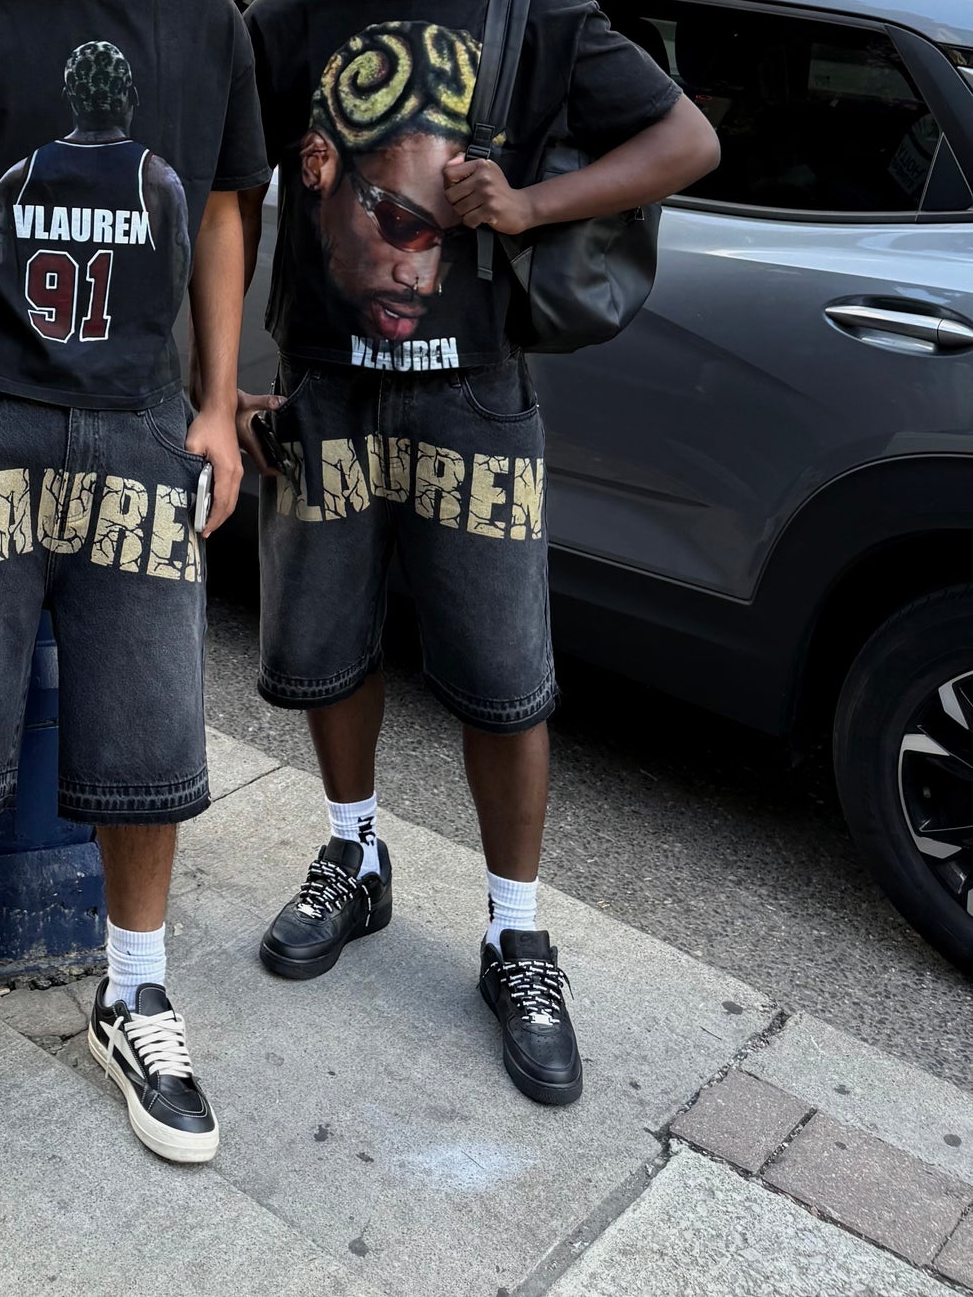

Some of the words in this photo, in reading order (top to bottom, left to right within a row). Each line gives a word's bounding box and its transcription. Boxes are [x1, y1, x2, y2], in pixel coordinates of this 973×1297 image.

[13, 204, 150, 245] VLAUREN
[25, 249, 114, 344] 91
[351, 334, 460, 372] VLAUREN
